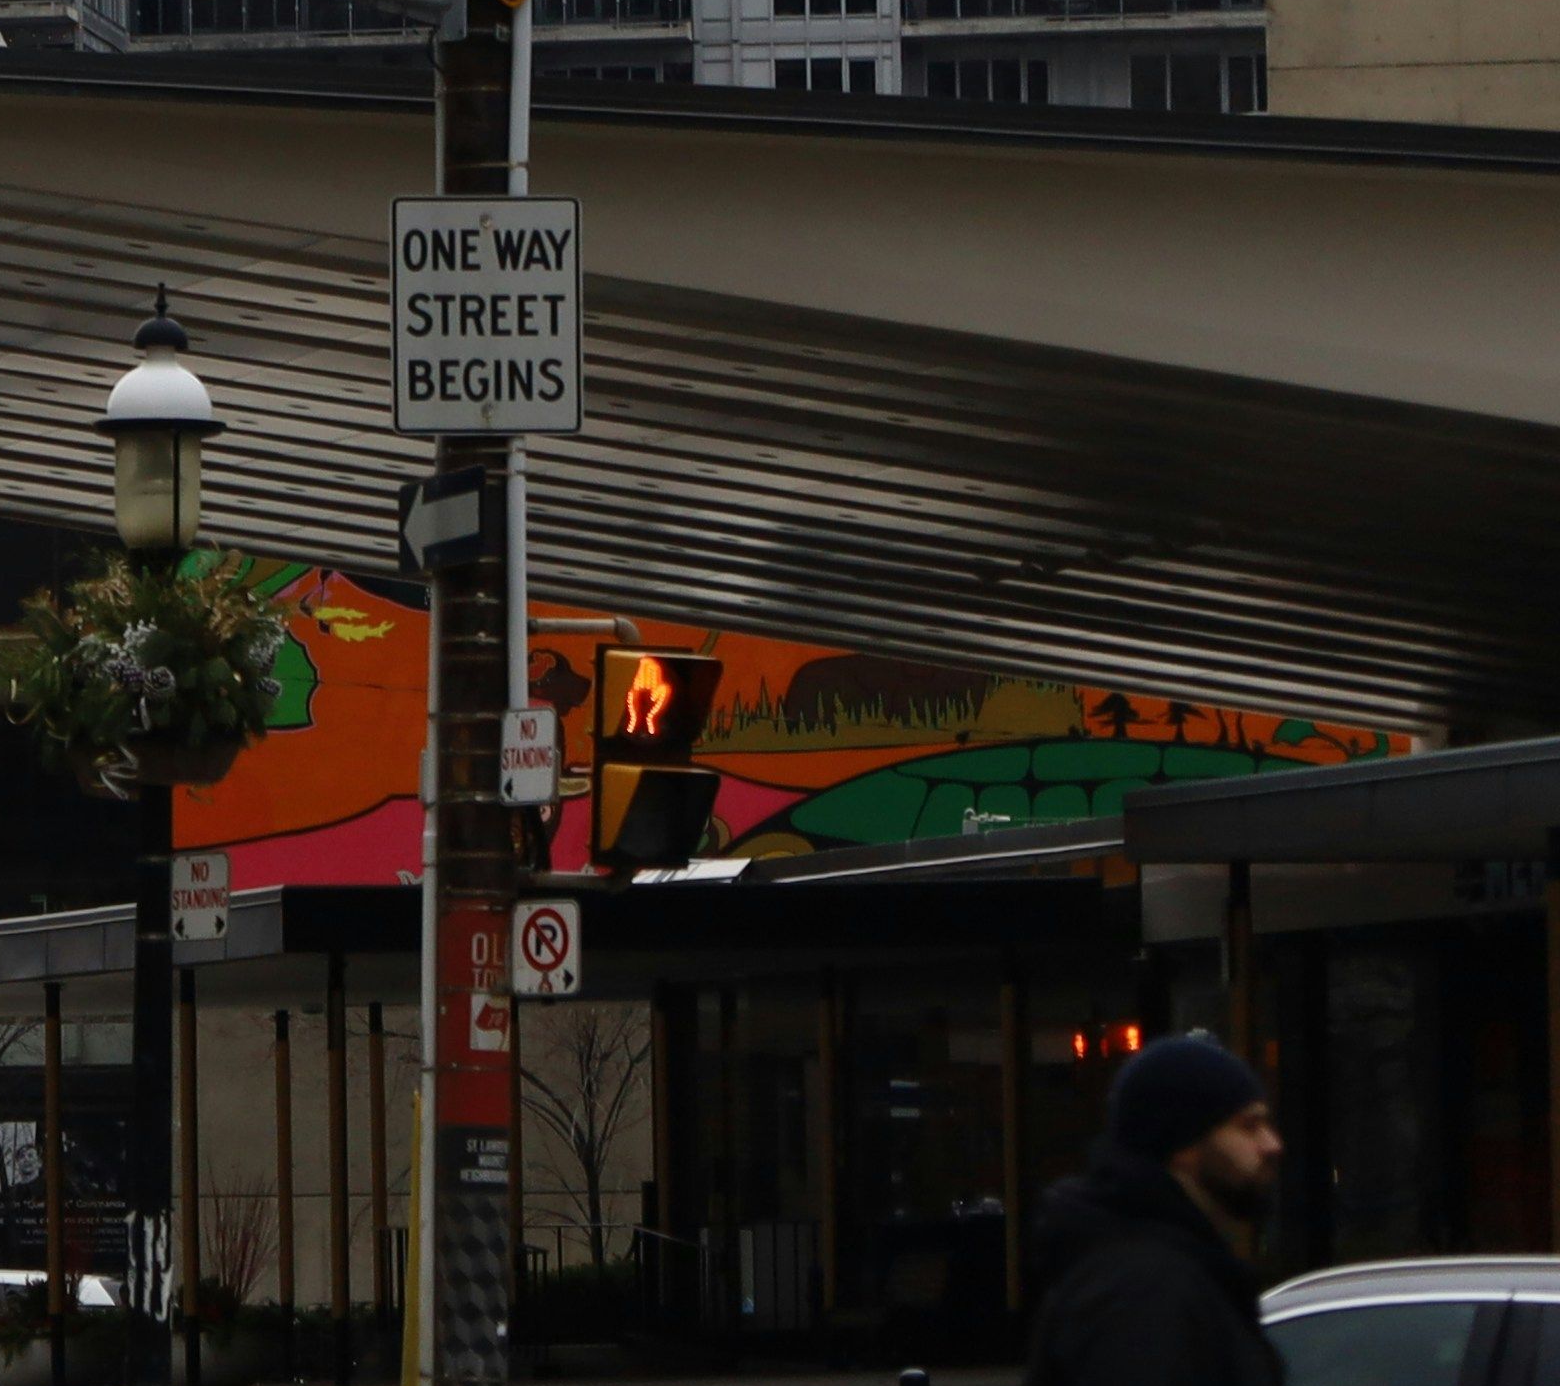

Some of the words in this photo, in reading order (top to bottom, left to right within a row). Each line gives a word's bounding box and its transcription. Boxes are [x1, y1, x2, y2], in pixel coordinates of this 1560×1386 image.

[402, 228, 482, 272] ONE
[493, 228, 571, 272] WAY
[406, 292, 566, 338] STREET
[407, 358, 565, 403] BEGINS
[521, 718, 537, 741] NO
[502, 745, 553, 771] STANDING
[190, 861, 210, 882] NO
[172, 886, 228, 911] STANDING
